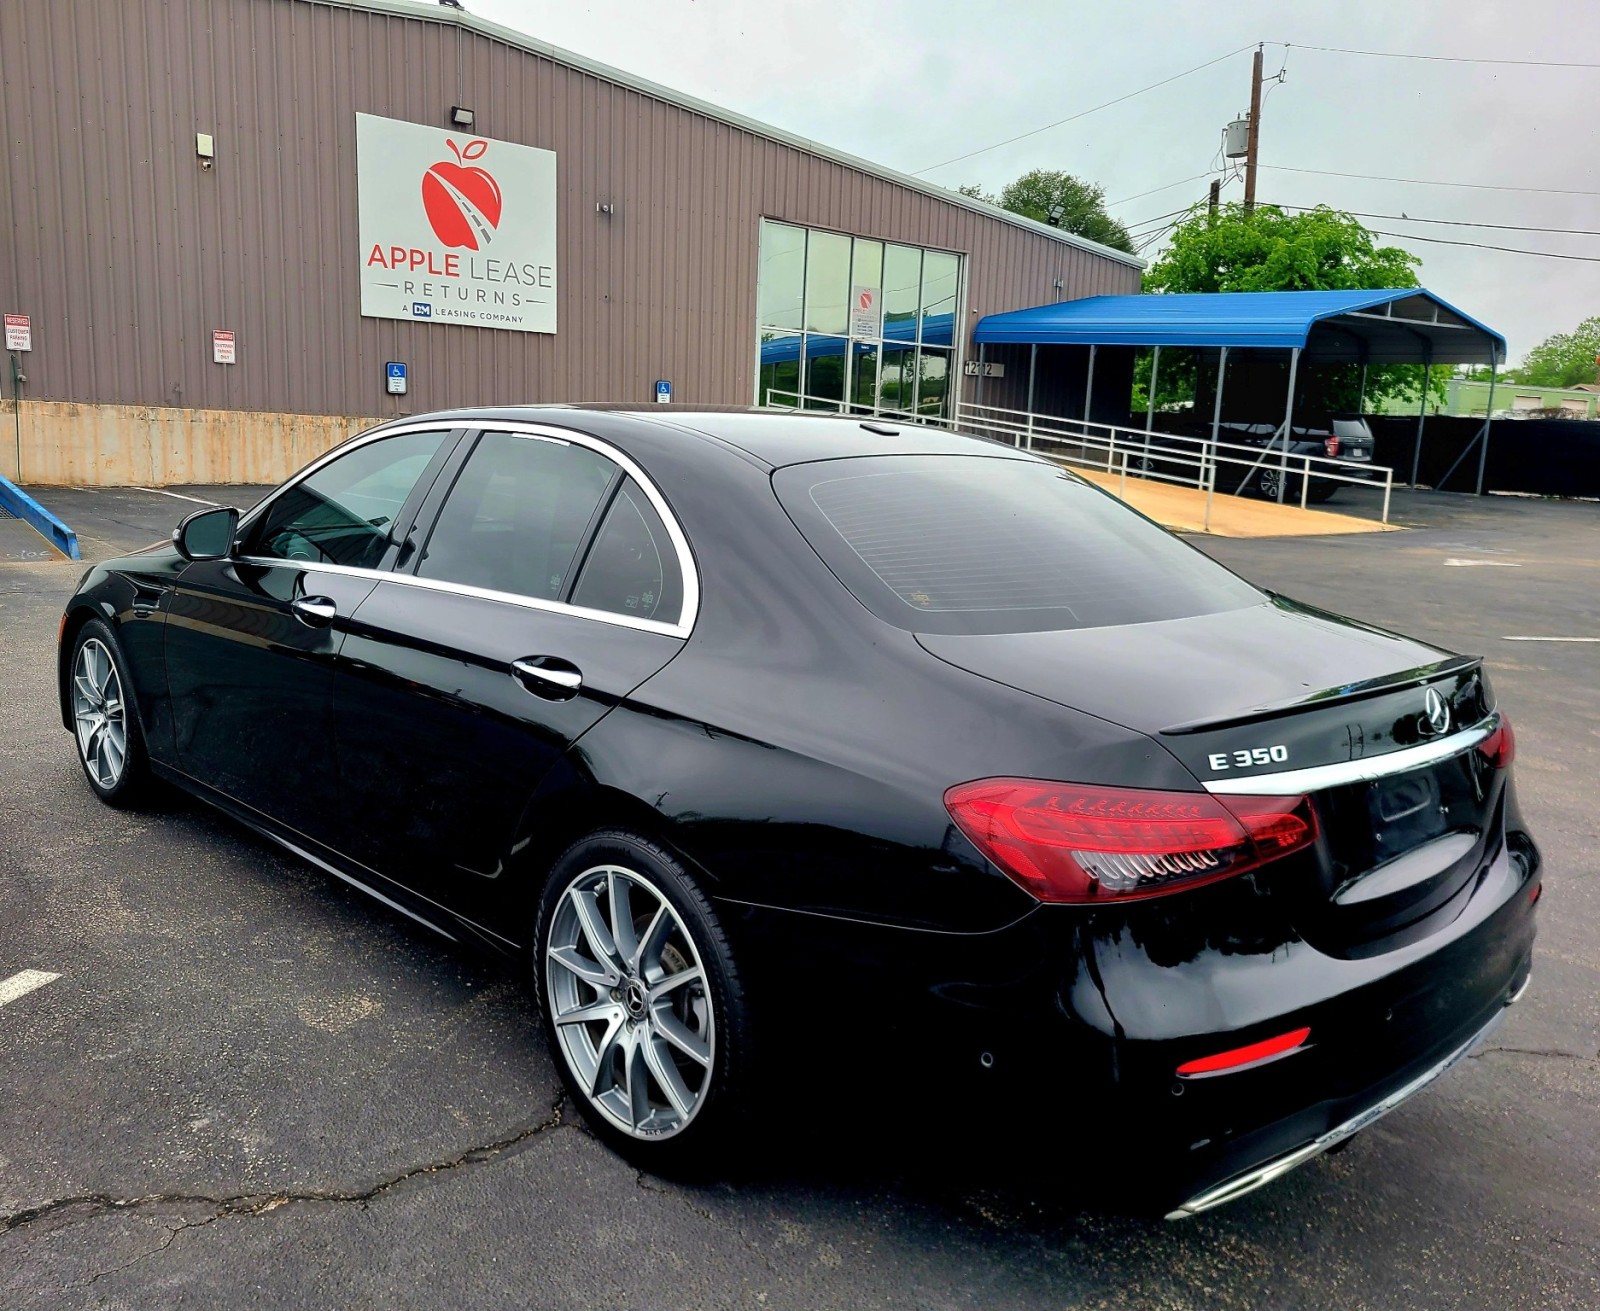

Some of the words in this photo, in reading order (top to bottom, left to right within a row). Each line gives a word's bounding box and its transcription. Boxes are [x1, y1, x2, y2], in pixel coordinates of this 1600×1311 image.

[367, 244, 460, 278] APPLE
[470, 257, 552, 288] LEASE
[404, 281, 521, 306] RETURNS
[402, 304, 409, 312] A
[435, 308, 476, 319] LEASING
[480, 312, 524, 324] COMPANY
[1208, 753, 1230, 771] E
[1232, 745, 1288, 767] 350
